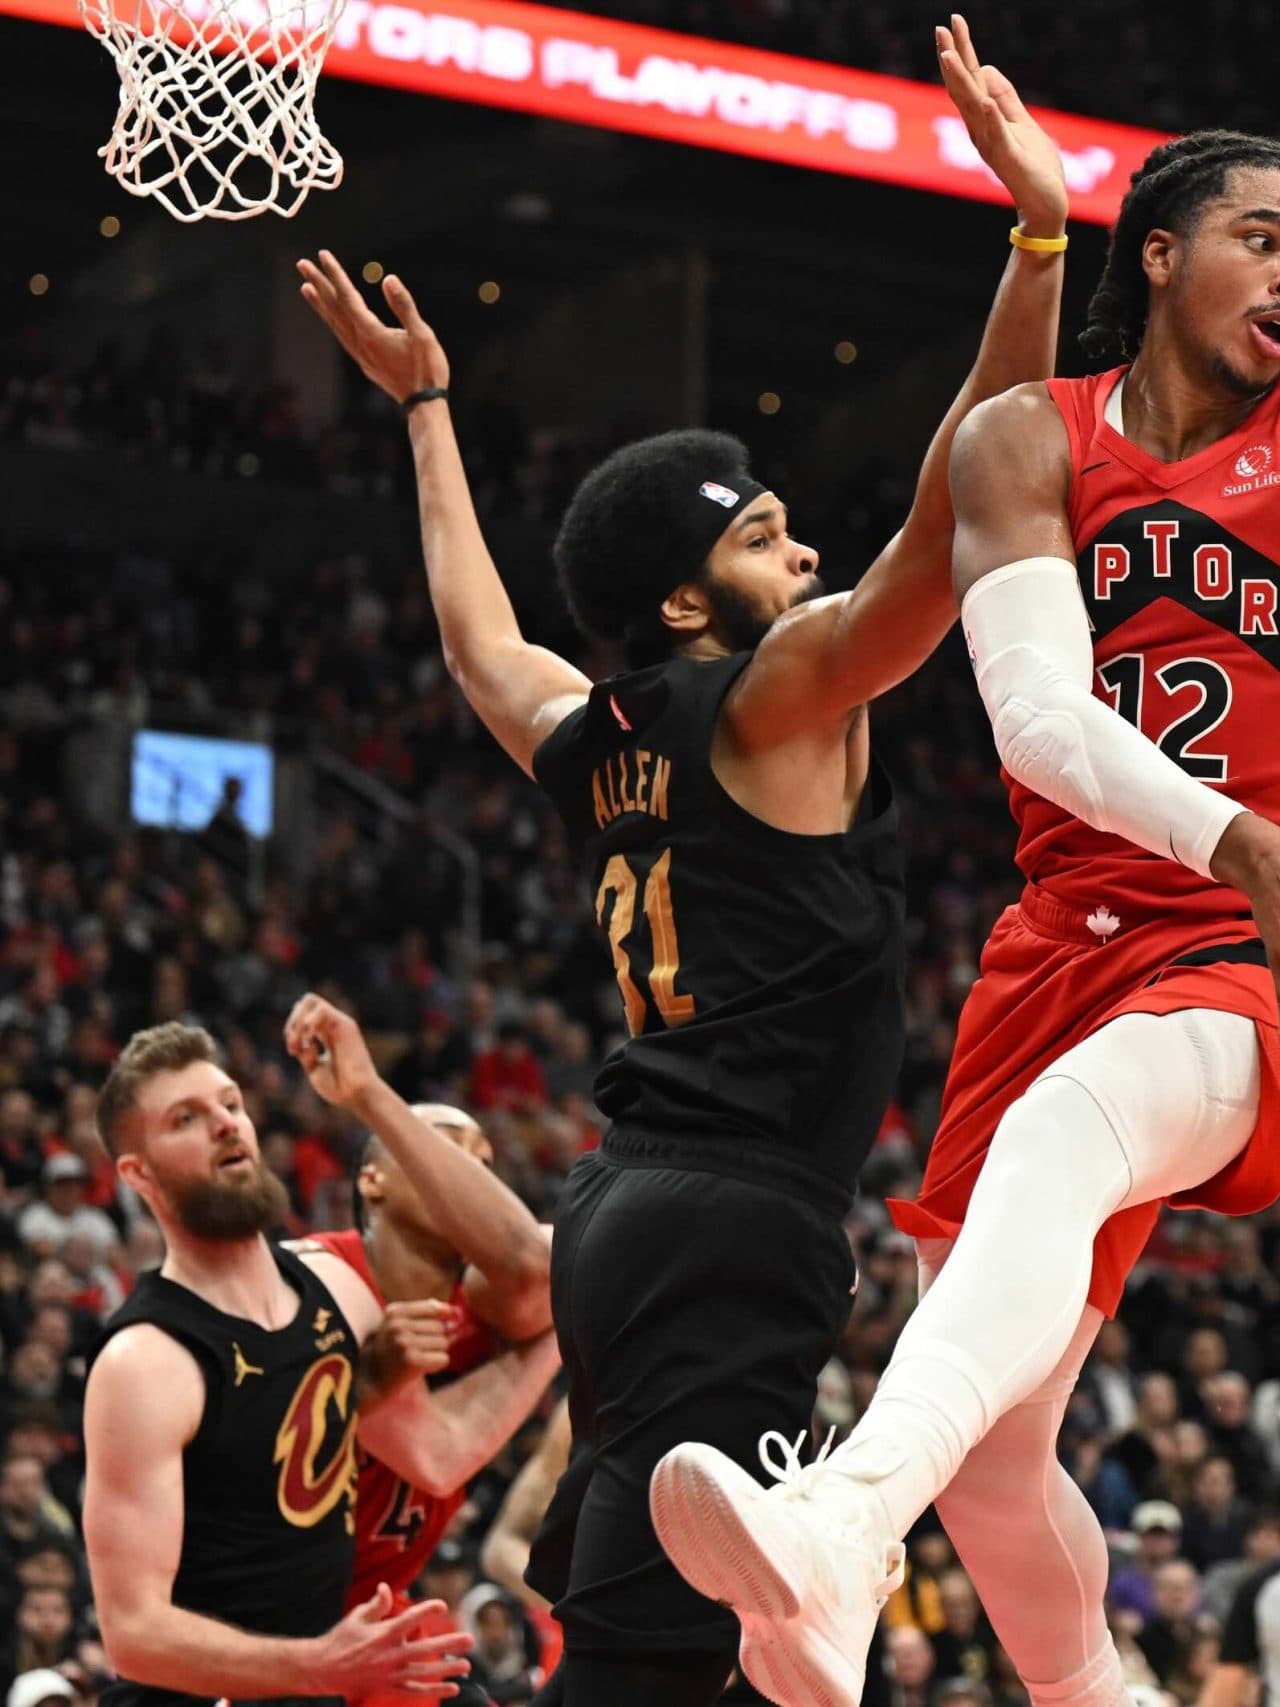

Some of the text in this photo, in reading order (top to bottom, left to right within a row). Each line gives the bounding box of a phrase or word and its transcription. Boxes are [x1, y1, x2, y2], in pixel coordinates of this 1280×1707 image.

[1223, 482, 1252, 497] Sun
[1096, 653, 1232, 783] 12
[592, 749, 672, 831] ALLEN
